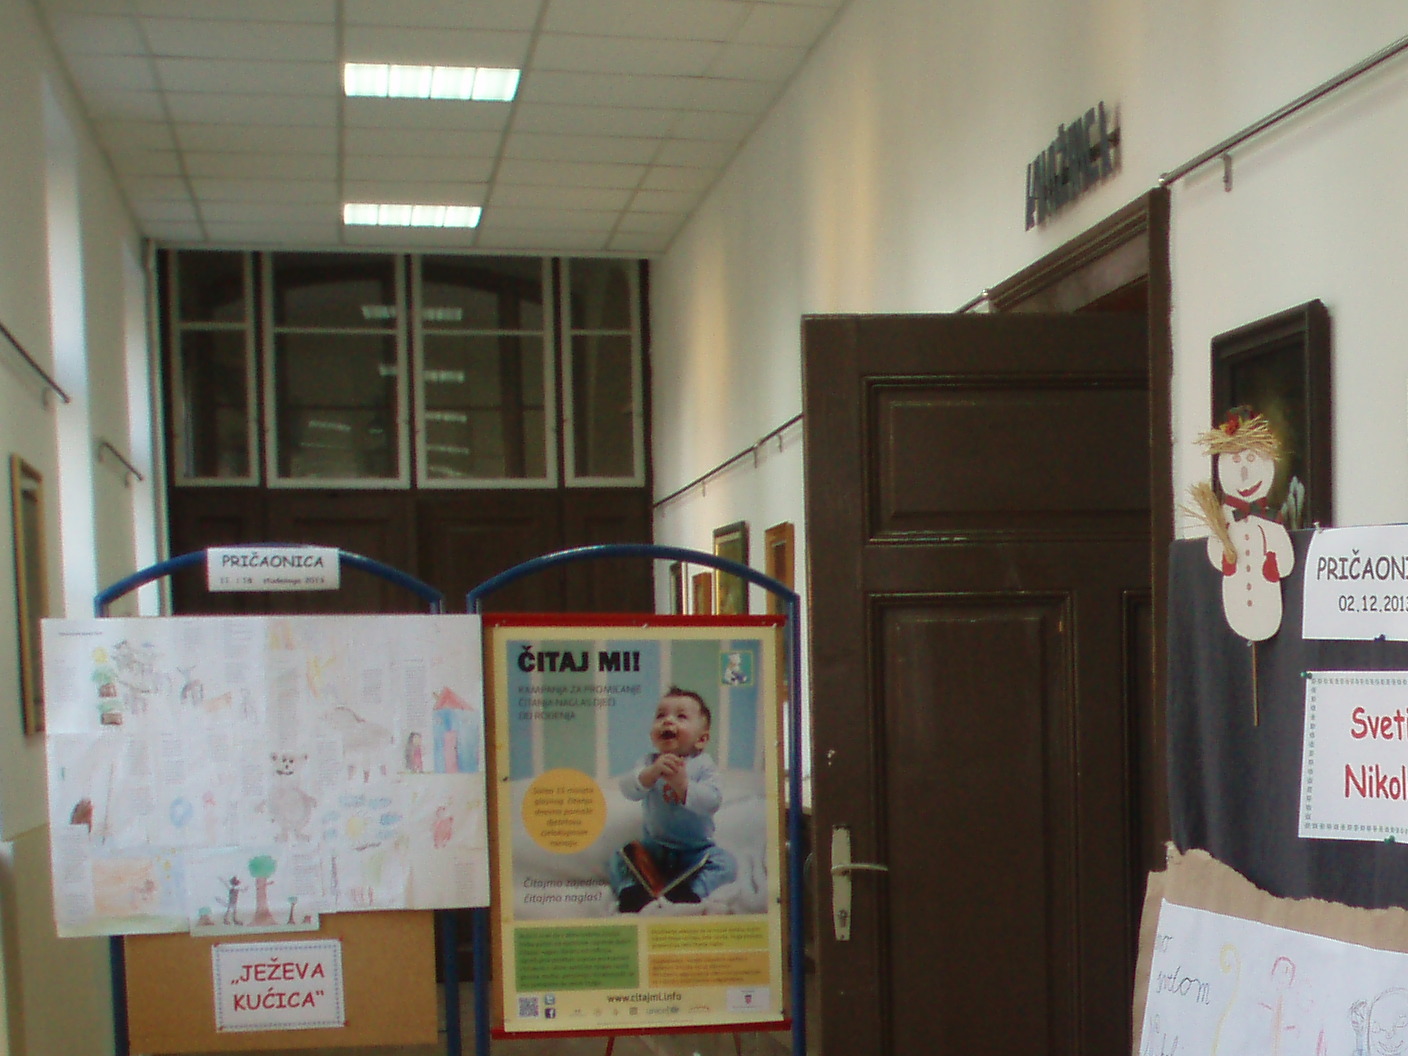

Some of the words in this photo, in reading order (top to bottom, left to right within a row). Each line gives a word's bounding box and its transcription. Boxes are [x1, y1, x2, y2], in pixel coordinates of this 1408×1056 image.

[222, 551, 325, 569] PRIČAONICA
[517, 645, 590, 674] ČITAJ
[598, 650, 641, 673] MI!
[523, 877, 563, 890] Čitajmo
[229, 957, 326, 987] „JEŽEVA
